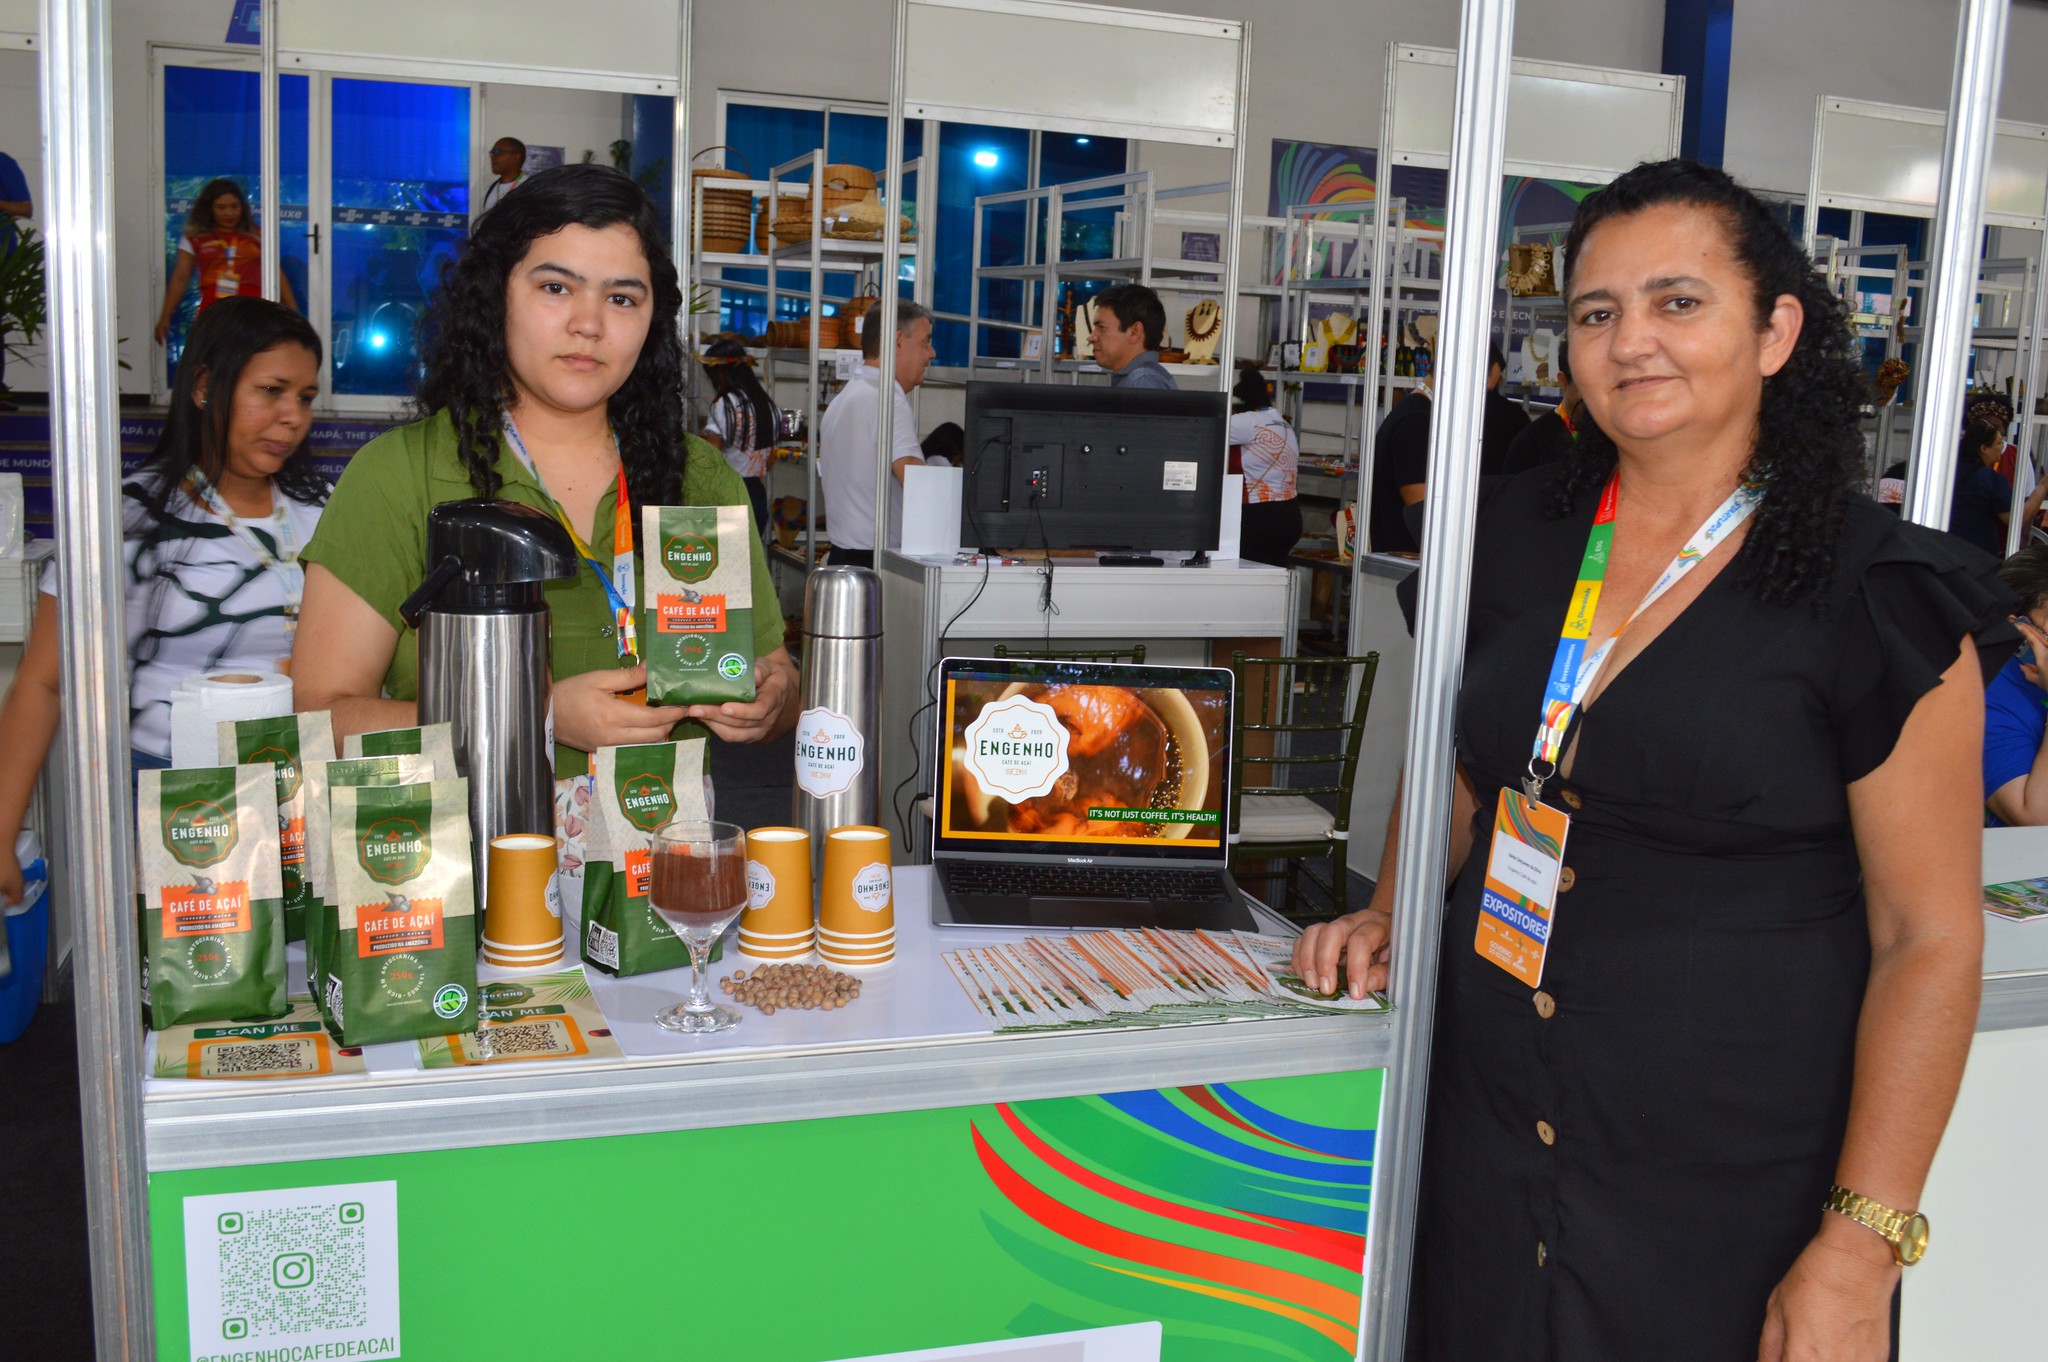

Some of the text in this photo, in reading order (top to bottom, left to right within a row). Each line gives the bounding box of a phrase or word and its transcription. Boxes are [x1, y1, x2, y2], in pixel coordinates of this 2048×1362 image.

[13, 458, 51, 468] MUND
[667, 550, 712, 562] ENGENHO
[663, 605, 720, 617] CAFÉ DE AÇAÍ
[796, 740, 856, 761] ENGENHO
[980, 740, 1053, 758] ENGENHO
[625, 793, 670, 810] ENGENHO
[1089, 809, 1217, 822] IT'S NOT JUST COFFEE, IT'S HEALTH!
[171, 824, 229, 841] ENGENHO
[366, 840, 422, 858] ENGENHO
[631, 861, 651, 876] CAFÉ
[857, 880, 890, 894] ENGENHO
[170, 894, 242, 914] CAFÉ DE AÇAÍ
[364, 912, 435, 933] CAFÉ DE AÇAÍ
[1483, 893, 1548, 940] EXPOSITORES
[179, 923, 204, 931] PRODUZIDO
[187, 936, 225, 956] ANTOCIANINA
[373, 942, 398, 951] PRODUZIDO
[405, 938, 429, 947] AMAZÔNIA
[381, 953, 418, 975] ANTOCIANINA
[193, 970, 209, 980] RICO
[406, 972, 426, 997] TANINOS
[387, 988, 403, 999] RICO
[479, 990, 523, 1001] NGENHO
[478, 1007, 546, 1019] CAN ME
[215, 1023, 301, 1037] SCAN ME
[196, 1336, 395, 1362] @ENGENHOCAFEDEACAI
